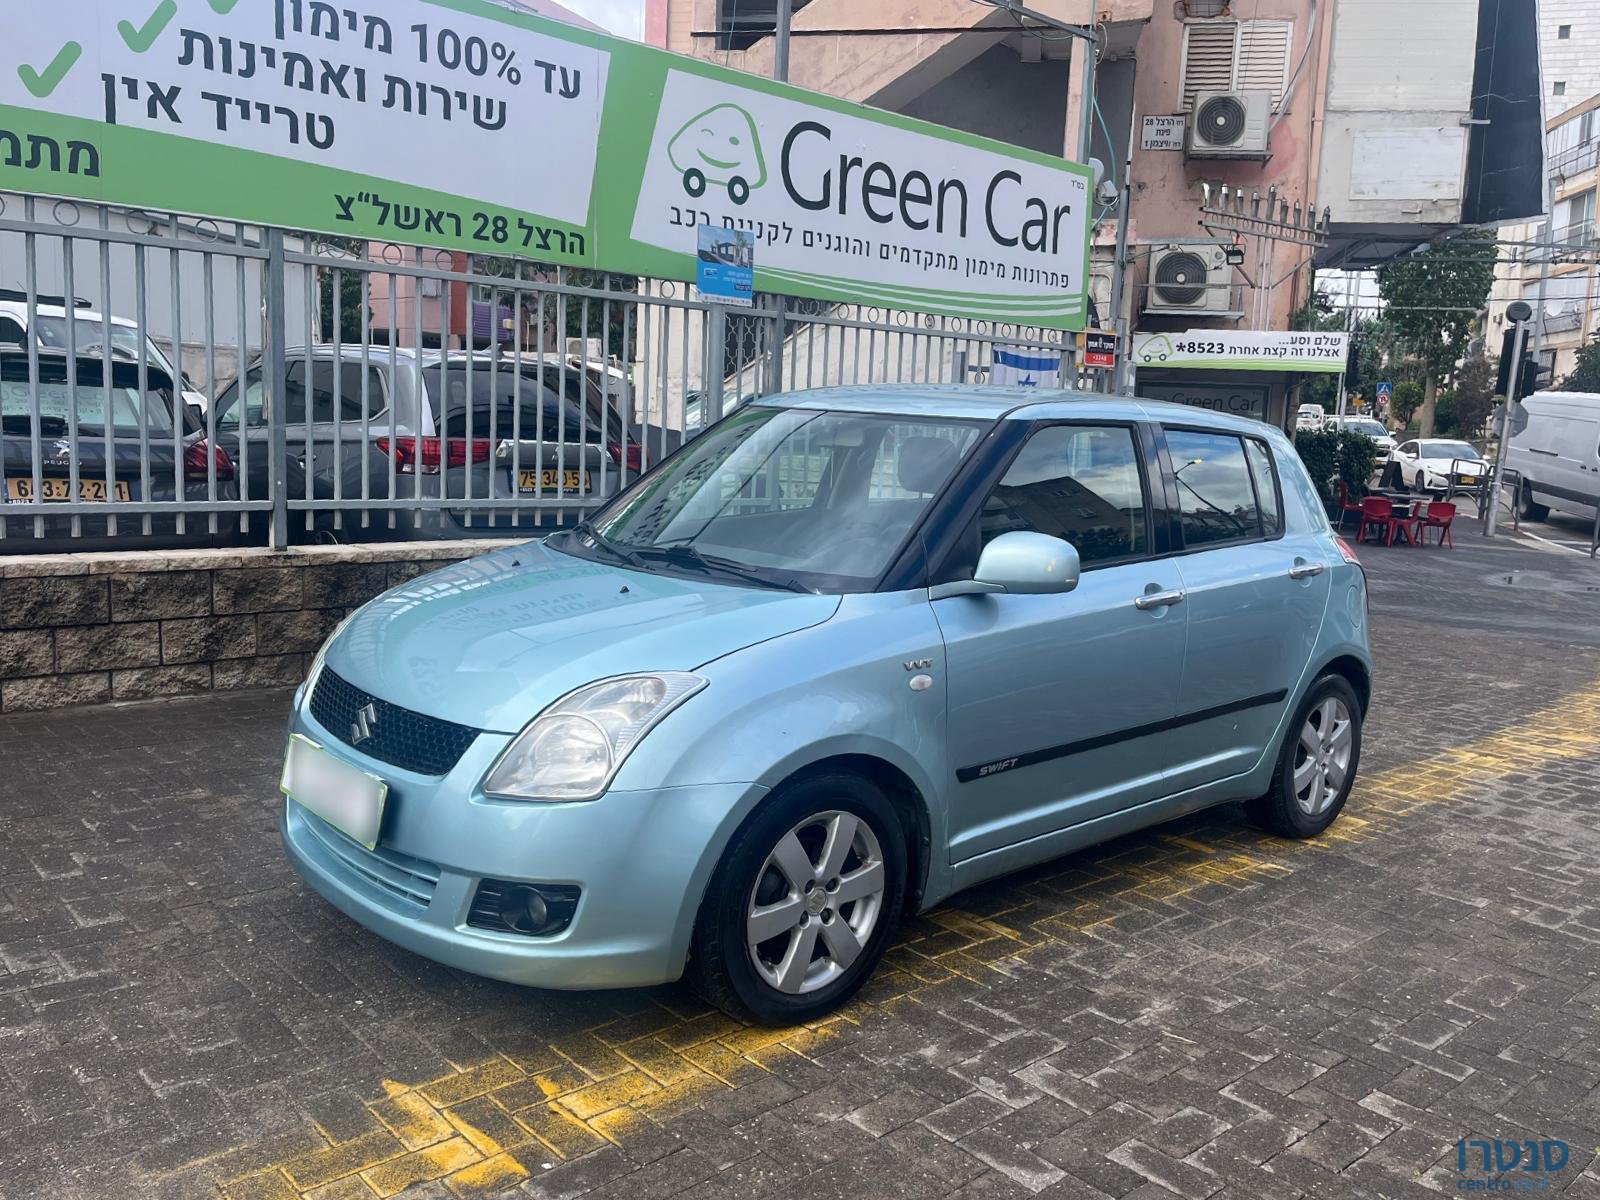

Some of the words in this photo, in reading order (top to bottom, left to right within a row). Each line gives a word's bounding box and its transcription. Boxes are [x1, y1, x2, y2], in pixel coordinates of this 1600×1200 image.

[274, 0, 393, 55] מימון
[178, 28, 366, 102] ואמינות
[410, 23, 521, 86] 100%
[534, 59, 581, 99] עד
[100, 72, 183, 124] אין
[382, 74, 507, 130] שירות
[201, 91, 335, 149] טרייד
[1145, 118, 1154, 126] 28
[1155, 116, 1175, 126] הרצל
[780, 120, 969, 239] Green
[984, 169, 1071, 256] Car
[472, 212, 509, 244] 28
[669, 206, 711, 228] רכב
[517, 217, 585, 256] הרצל
[802, 230, 871, 257] והוגנים
[879, 243, 958, 271] מתקדמים
[965, 257, 1006, 278] מימון
[1012, 265, 1069, 289] פתרונות
[1228, 346, 1260, 356] אחרת
[1262, 347, 1287, 358] קצת
[1290, 348, 1304, 356] זה
[1307, 348, 1340, 357] אצלנו
[1315, 335, 1342, 346] שלם
[1228, 394, 1258, 412] Car
[978, 757, 1019, 777] SWIFT
